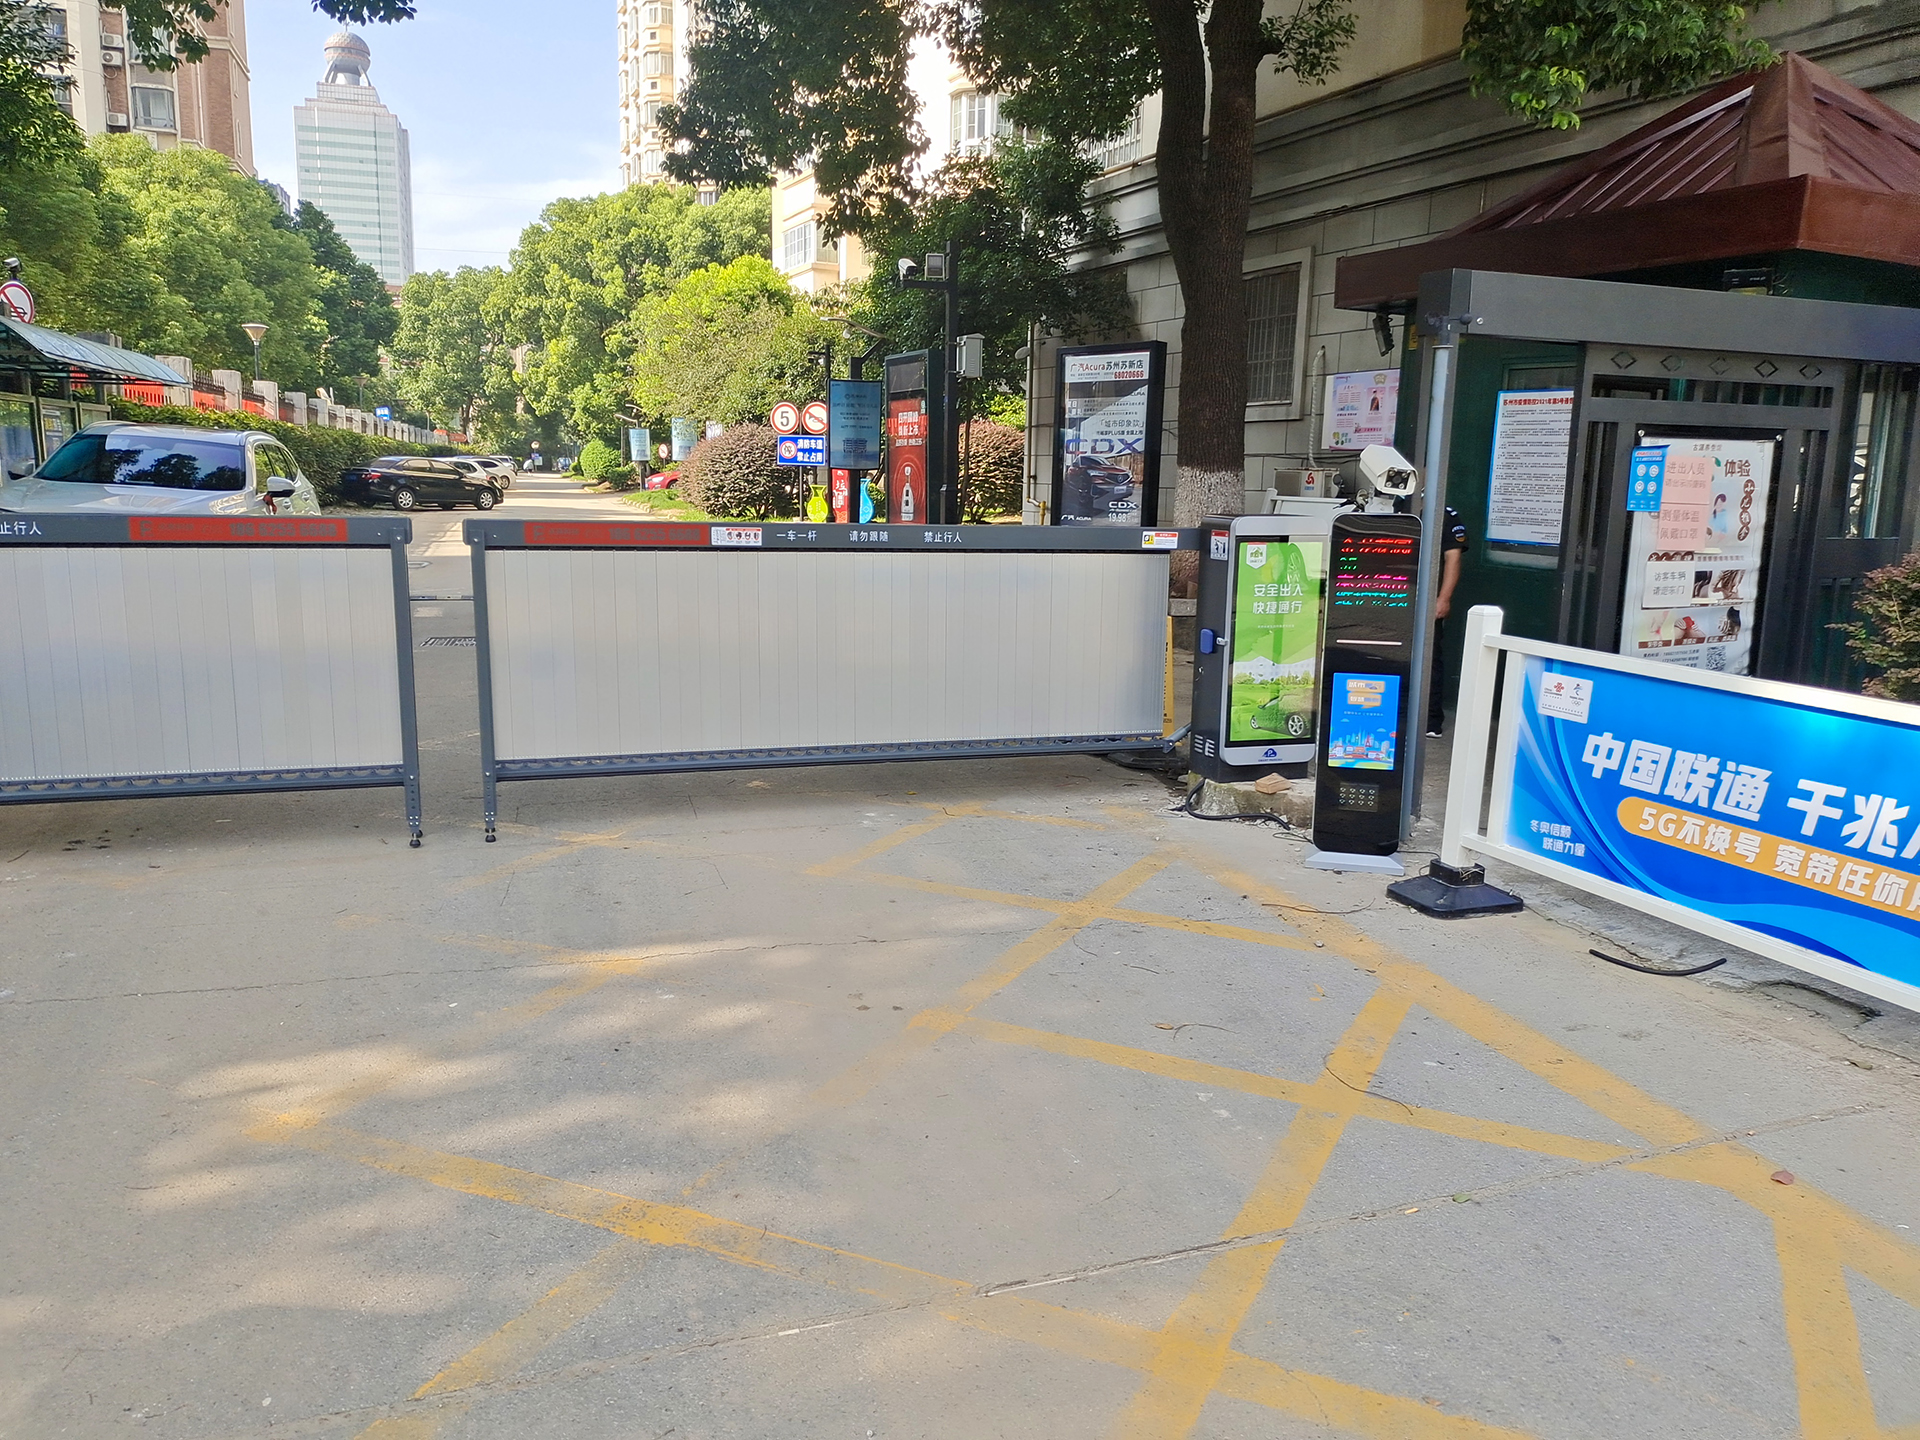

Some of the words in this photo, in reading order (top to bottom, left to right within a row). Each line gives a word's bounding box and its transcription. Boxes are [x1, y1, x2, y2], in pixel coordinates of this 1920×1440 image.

[1070, 359, 1144, 372] 广汽Acura苏州苏新店
[1114, 370, 1145, 380] 68020666
[780, 411, 790, 427] 5
[797, 438, 823, 450] 消防车道
[1066, 437, 1143, 455] CDX
[1666, 462, 1706, 475] 进出人员
[1724, 459, 1752, 478] 体验
[1108, 501, 1137, 509] CDX
[1661, 509, 1700, 523] 测量体温
[0, 521, 42, 535] 止行人
[1659, 527, 1699, 540] 佩戴口罩
[776, 529, 817, 542] 一车一杆
[849, 530, 889, 542] 请勿跟随
[923, 531, 963, 543] 禁止行人
[1253, 583, 1304, 597] 安全出入
[1252, 600, 1303, 614] 快捷通行
[1581, 731, 1773, 822] 中国联通
[1786, 778, 1920, 860] 千兆
[1638, 806, 1762, 864] 5G不换号
[1542, 836, 1586, 857] 联通力量
